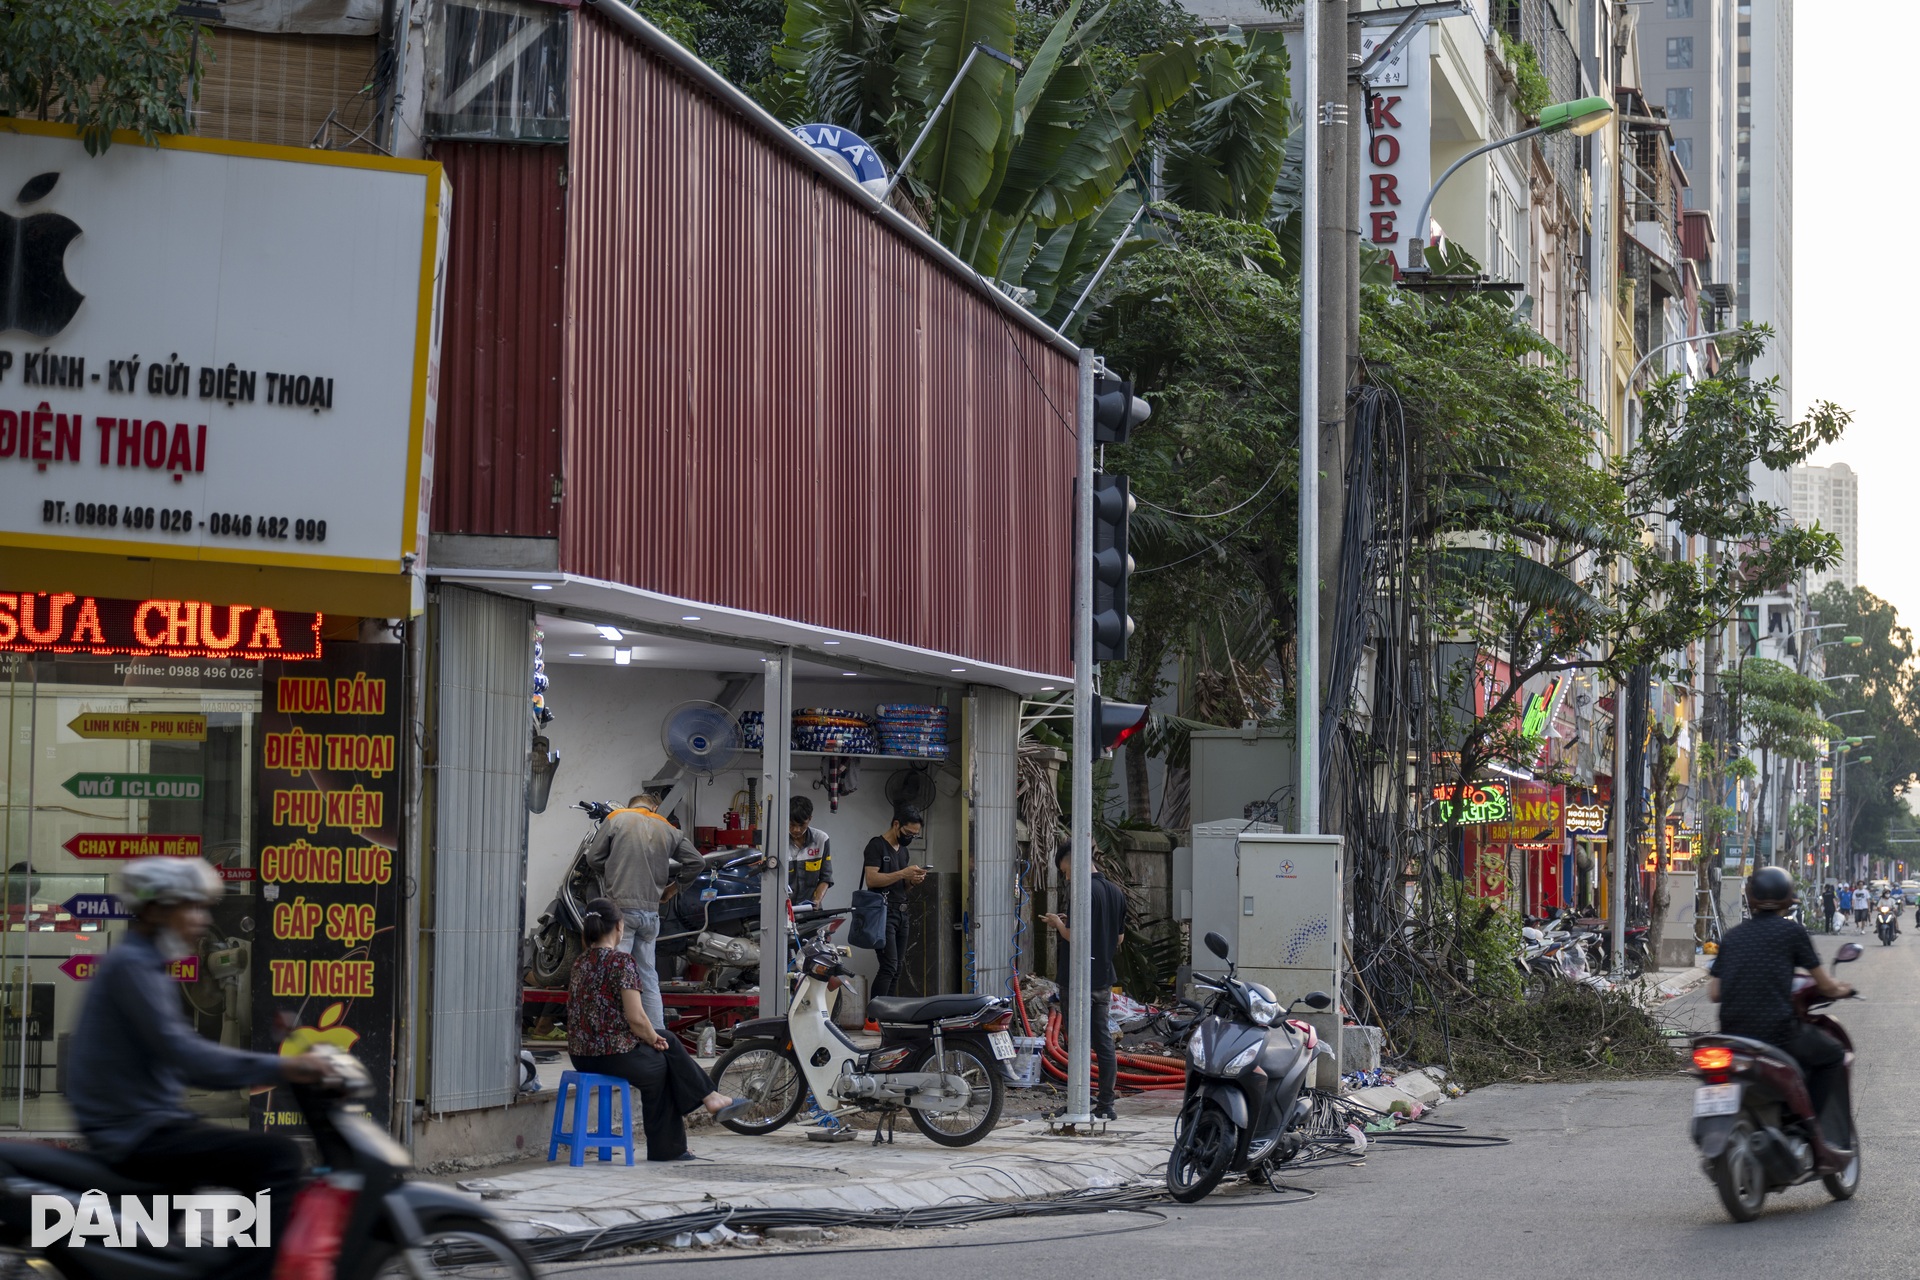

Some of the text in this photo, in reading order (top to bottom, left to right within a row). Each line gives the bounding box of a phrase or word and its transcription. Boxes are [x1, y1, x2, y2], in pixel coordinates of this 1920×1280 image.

[23, 347, 85, 388] KÍNH
[108, 354, 140, 393] KÝ
[148, 352, 190, 396] GỬI
[199, 362, 256, 407] ĐIỆN
[266, 371, 334, 413] THOẠI
[0, 401, 207, 482] ĐIỆN THOẠI
[43, 500, 69, 523] ĐT:
[75, 502, 118, 527] 0988
[122, 506, 155, 530] 496
[160, 508, 192, 532] 026
[210, 512, 252, 537] 0846
[257, 516, 289, 539] 482
[295, 518, 327, 542] 999
[114, 663, 165, 677] Hotline:
[168, 665, 200, 678] 0988
[203, 666, 227, 679] 496
[230, 667, 254, 680] 026
[278, 672, 385, 715] MUA BÁN
[84, 719, 110, 732] LINH
[113, 717, 140, 735] KIỆN
[151, 720, 174, 736] PHỤ
[177, 719, 204, 736] KIỆN
[264, 727, 395, 778] ĐIỆN THOẠI
[79, 776, 200, 798] MỞ ICLOUD
[273, 784, 383, 835] PHỤ KIỆN
[79, 840, 116, 857] CHẠY
[261, 839, 343, 883] CƯỜNG
[227, 870, 252, 878] SANG
[77, 899, 110, 915] PHÁ
[273, 896, 376, 948] CÁP SẠC
[270, 960, 375, 997] TAI NGHE
[263, 1112, 275, 1125] 75
